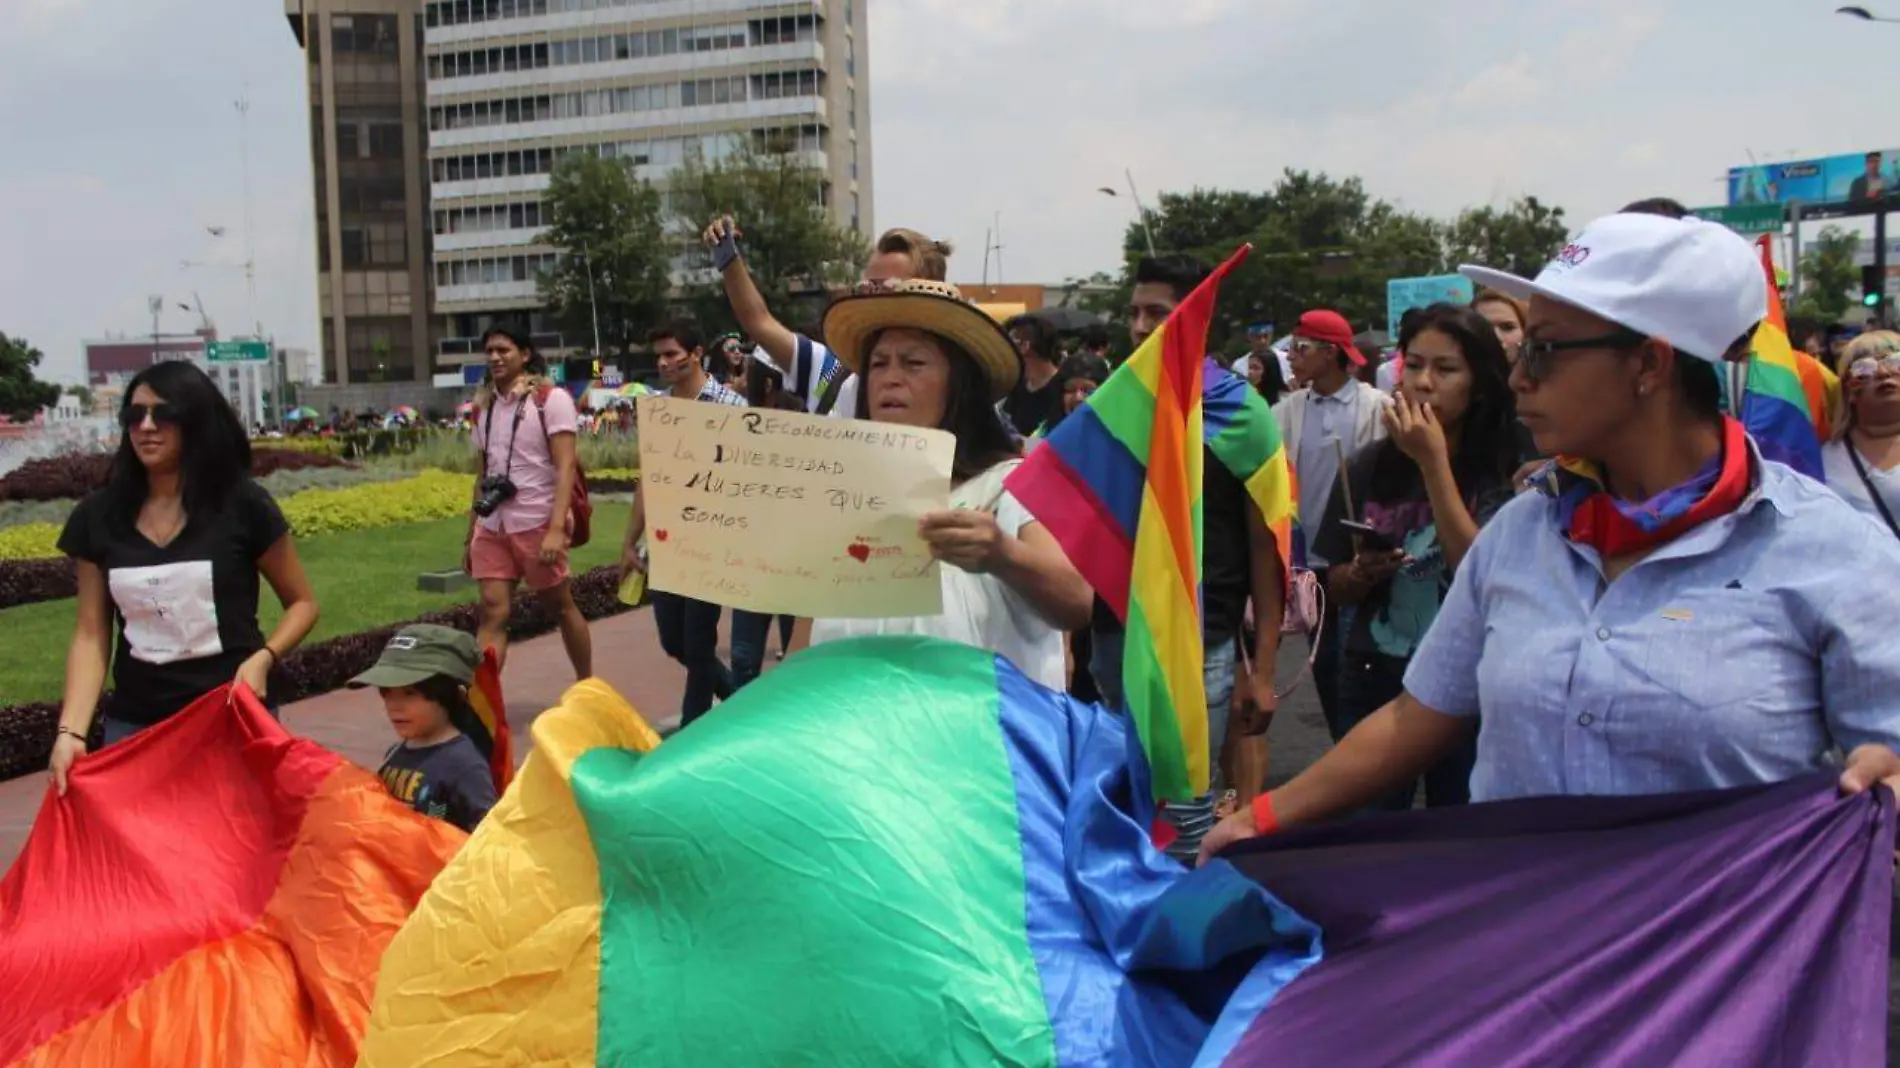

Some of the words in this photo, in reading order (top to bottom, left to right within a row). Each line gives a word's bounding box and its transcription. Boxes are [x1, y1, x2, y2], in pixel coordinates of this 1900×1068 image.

[648, 398, 688, 426] Por
[705, 412, 731, 433] el
[741, 411, 928, 451] RECONOCIMIENTO
[713, 443, 845, 475] DIVERSIDAD
[684, 470, 806, 500] MUJERES
[824, 488, 887, 516] QUE
[681, 505, 749, 529] SOMOS
